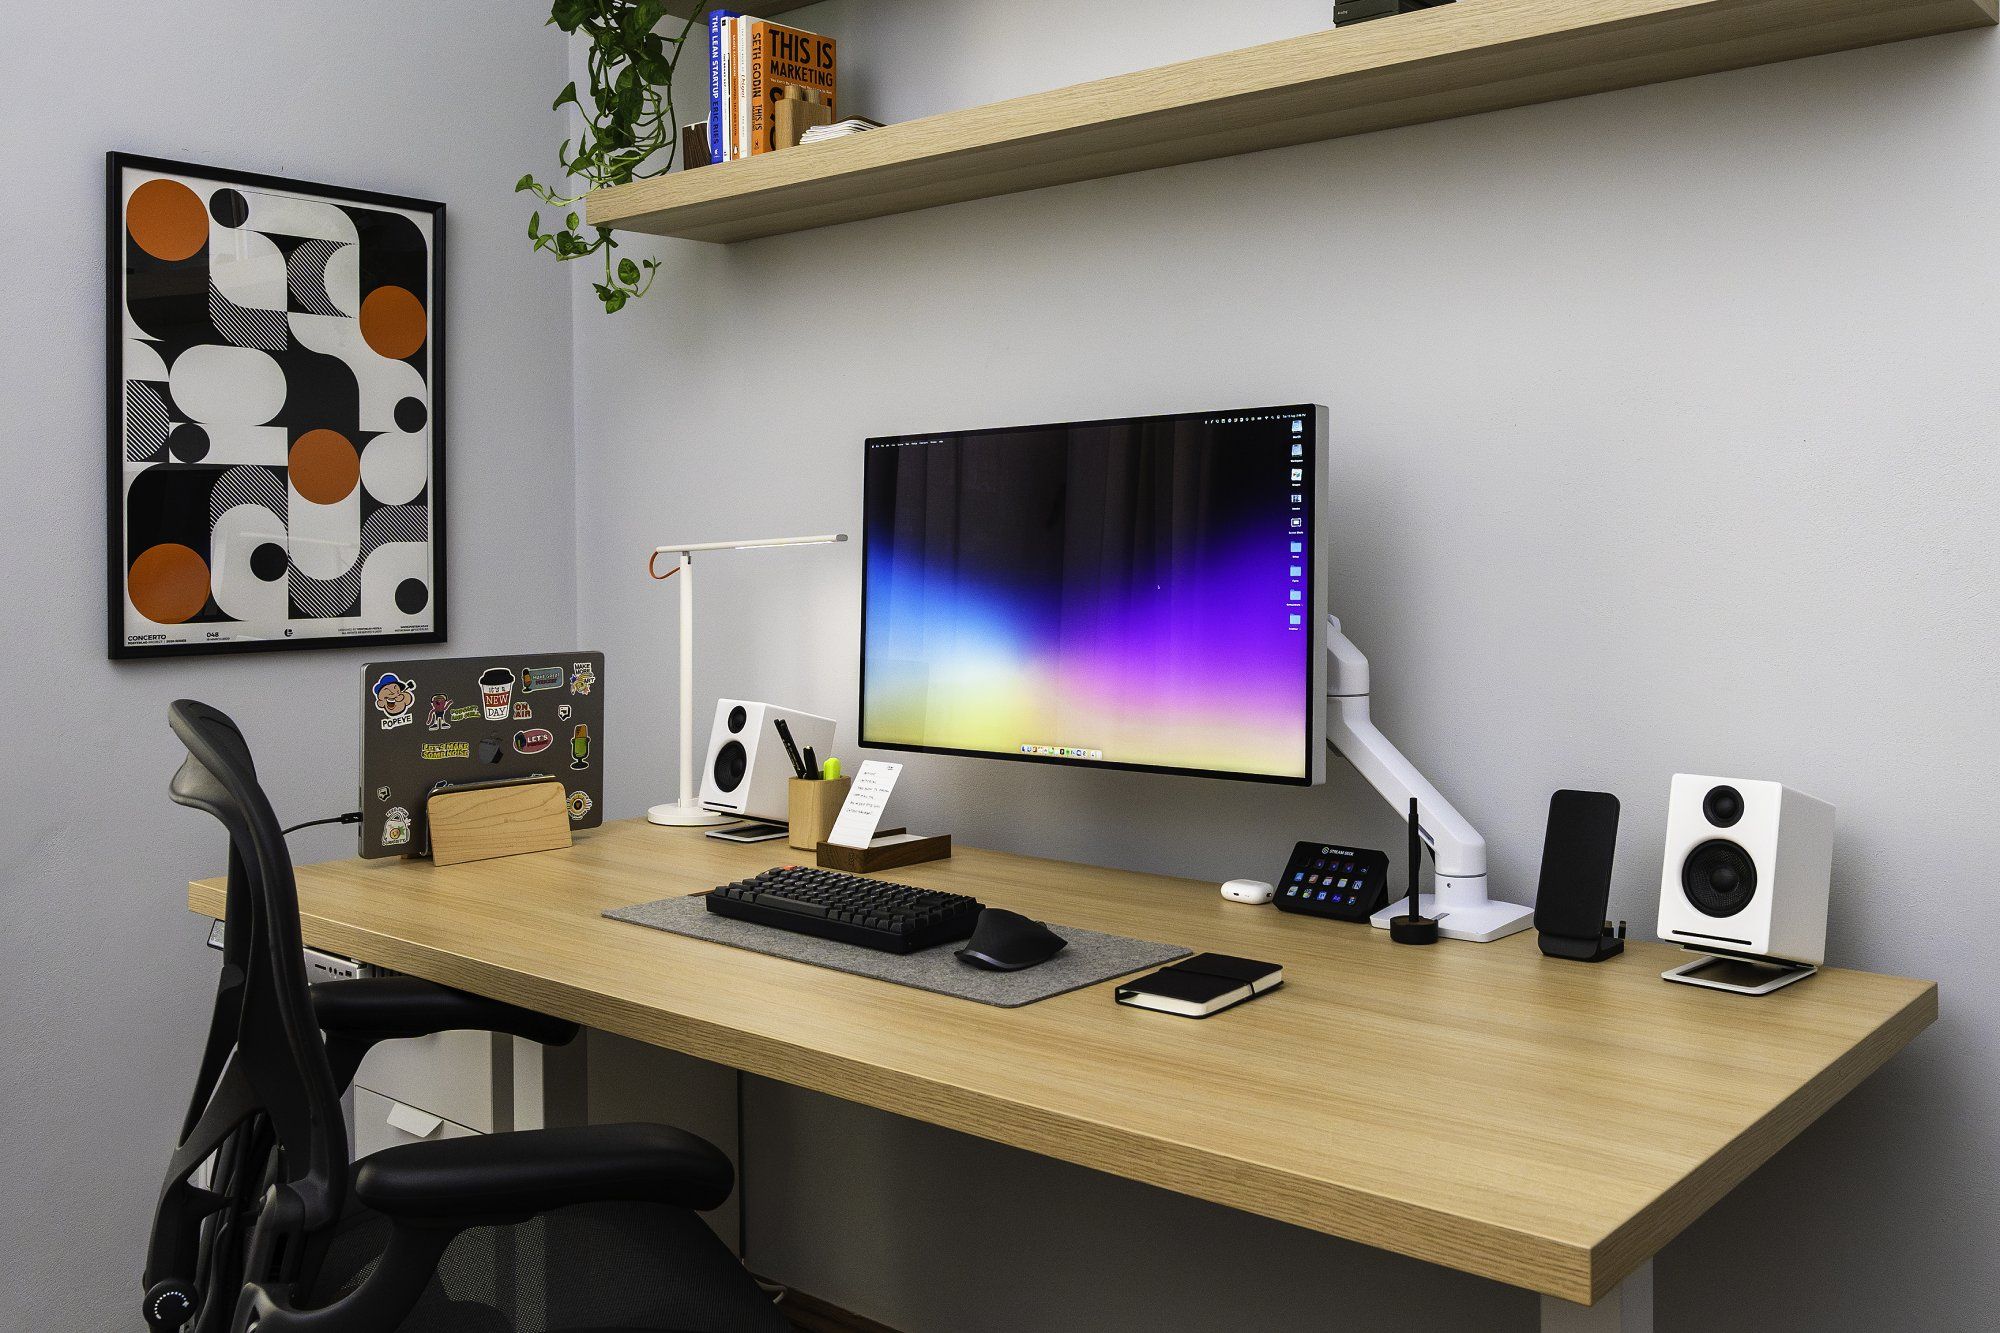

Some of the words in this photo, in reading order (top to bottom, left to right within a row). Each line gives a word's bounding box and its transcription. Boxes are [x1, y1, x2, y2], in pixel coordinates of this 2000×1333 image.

[752, 32, 761, 60] SETH
[769, 29, 810, 64] THIS
[817, 41, 832, 69] IS
[752, 63, 761, 98] GODIN
[771, 60, 832, 87] MARKETING
[486, 694, 509, 704] NEW
[488, 707, 506, 716] DAY
[382, 715, 412, 728] POPEYE
